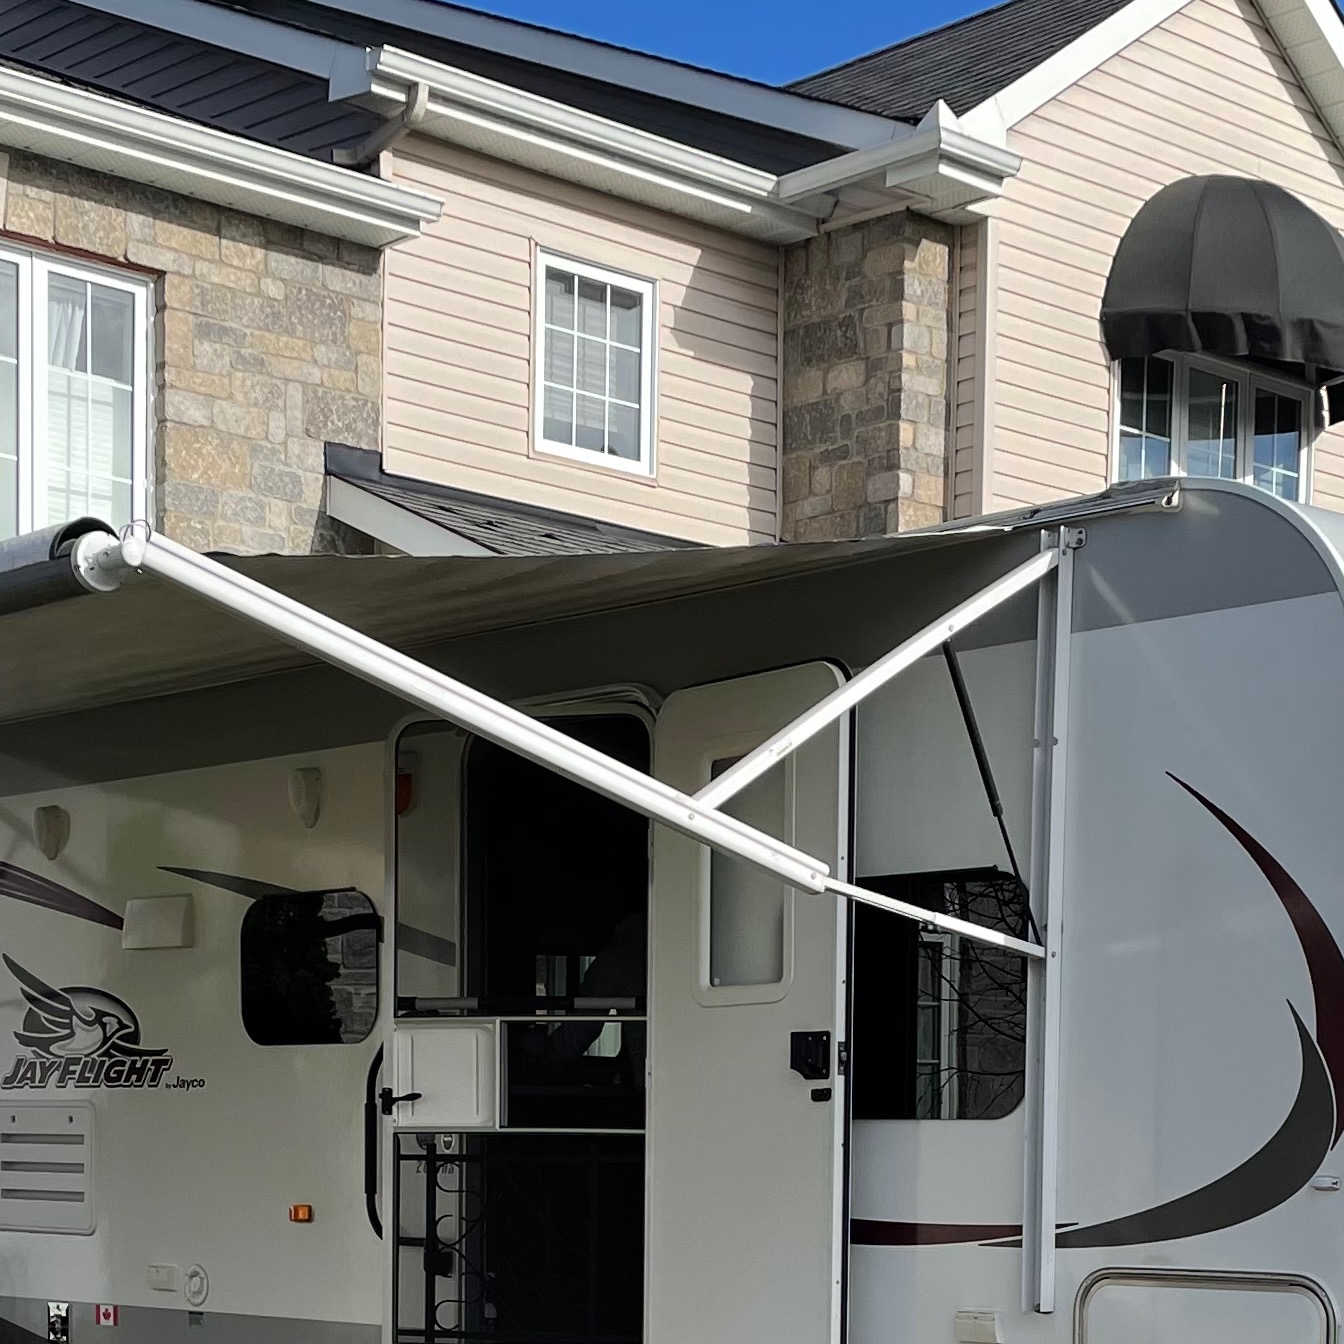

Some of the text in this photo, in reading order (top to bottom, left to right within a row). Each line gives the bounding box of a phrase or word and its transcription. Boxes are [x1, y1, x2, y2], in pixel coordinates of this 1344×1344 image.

[1, 1055, 59, 1089] JAY
[54, 1054, 173, 1089] FLIGHT
[172, 1075, 205, 1091] Jayco
